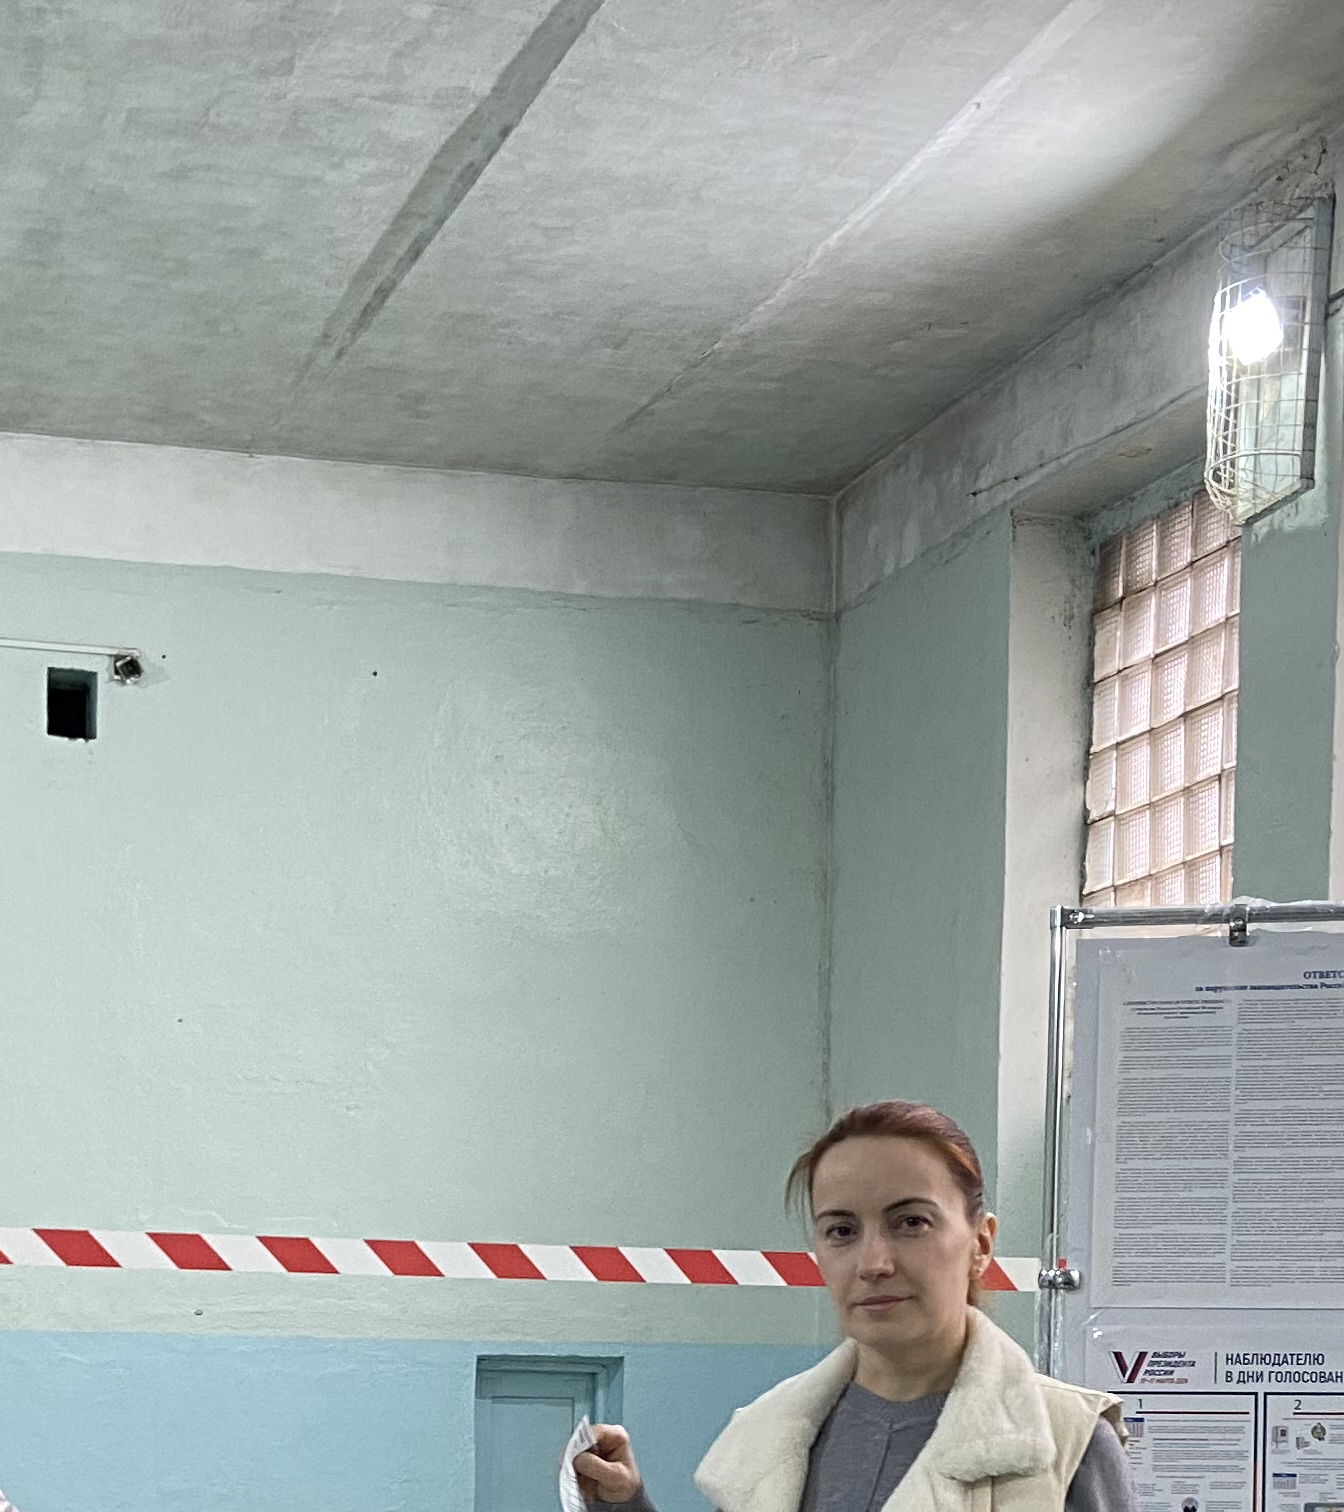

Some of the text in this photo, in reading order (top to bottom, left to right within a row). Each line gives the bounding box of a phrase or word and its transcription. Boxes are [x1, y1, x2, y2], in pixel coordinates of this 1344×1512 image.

[1225, 1353, 1325, 1367] НАБЛЮДАТЕЛЮ
[1225, 1370, 1234, 1383] В
[1236, 1370, 1264, 1384] ДНИ
[1294, 1399, 1302, 1410] 2
